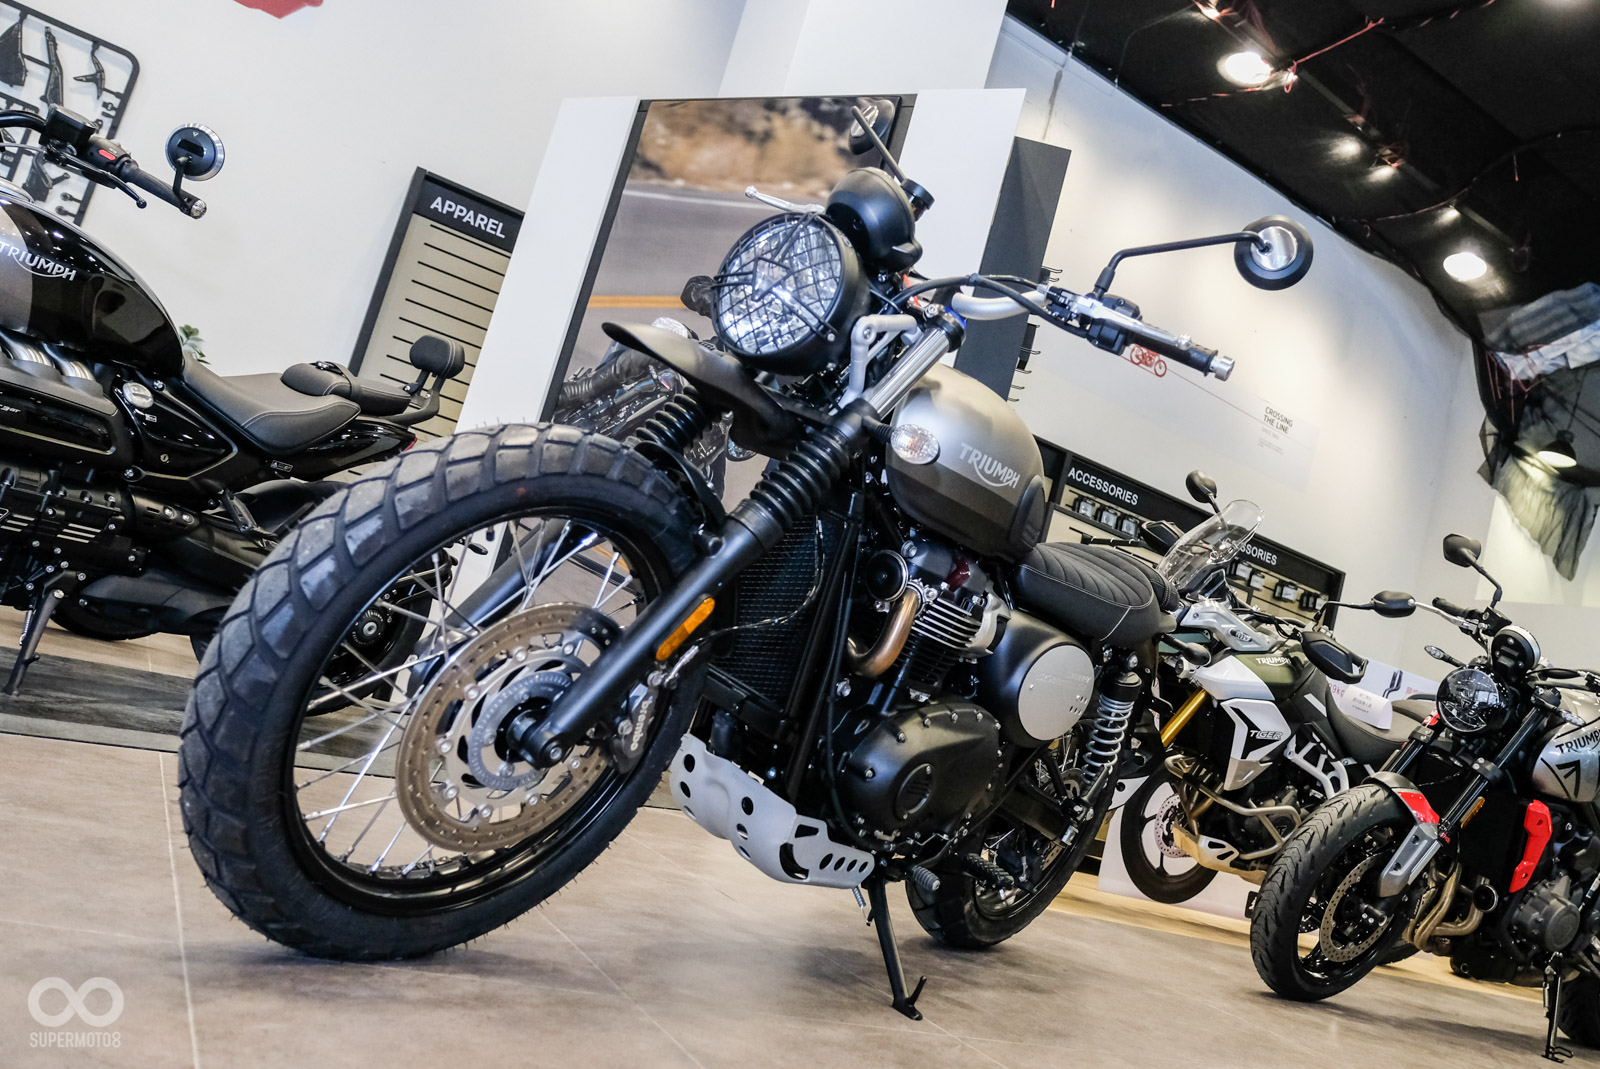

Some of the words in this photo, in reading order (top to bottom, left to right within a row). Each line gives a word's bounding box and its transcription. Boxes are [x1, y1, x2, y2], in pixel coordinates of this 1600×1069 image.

[429, 196, 506, 239] APPAREL
[0, 241, 77, 281] TRIUMPH
[1264, 414, 1275, 426] THE
[1276, 421, 1289, 434] LINE
[1265, 406, 1293, 427] CROSSING
[959, 441, 1021, 489] TRIUMPH
[1067, 467, 1139, 506] ACCESSORIES
[1240, 543, 1278, 566] SSORIES
[1256, 657, 1292, 667] TRIUMPH
[630, 700, 651, 751] brembo
[1249, 729, 1283, 740] TIGER
[1555, 728, 1600, 754] TRIUMP
